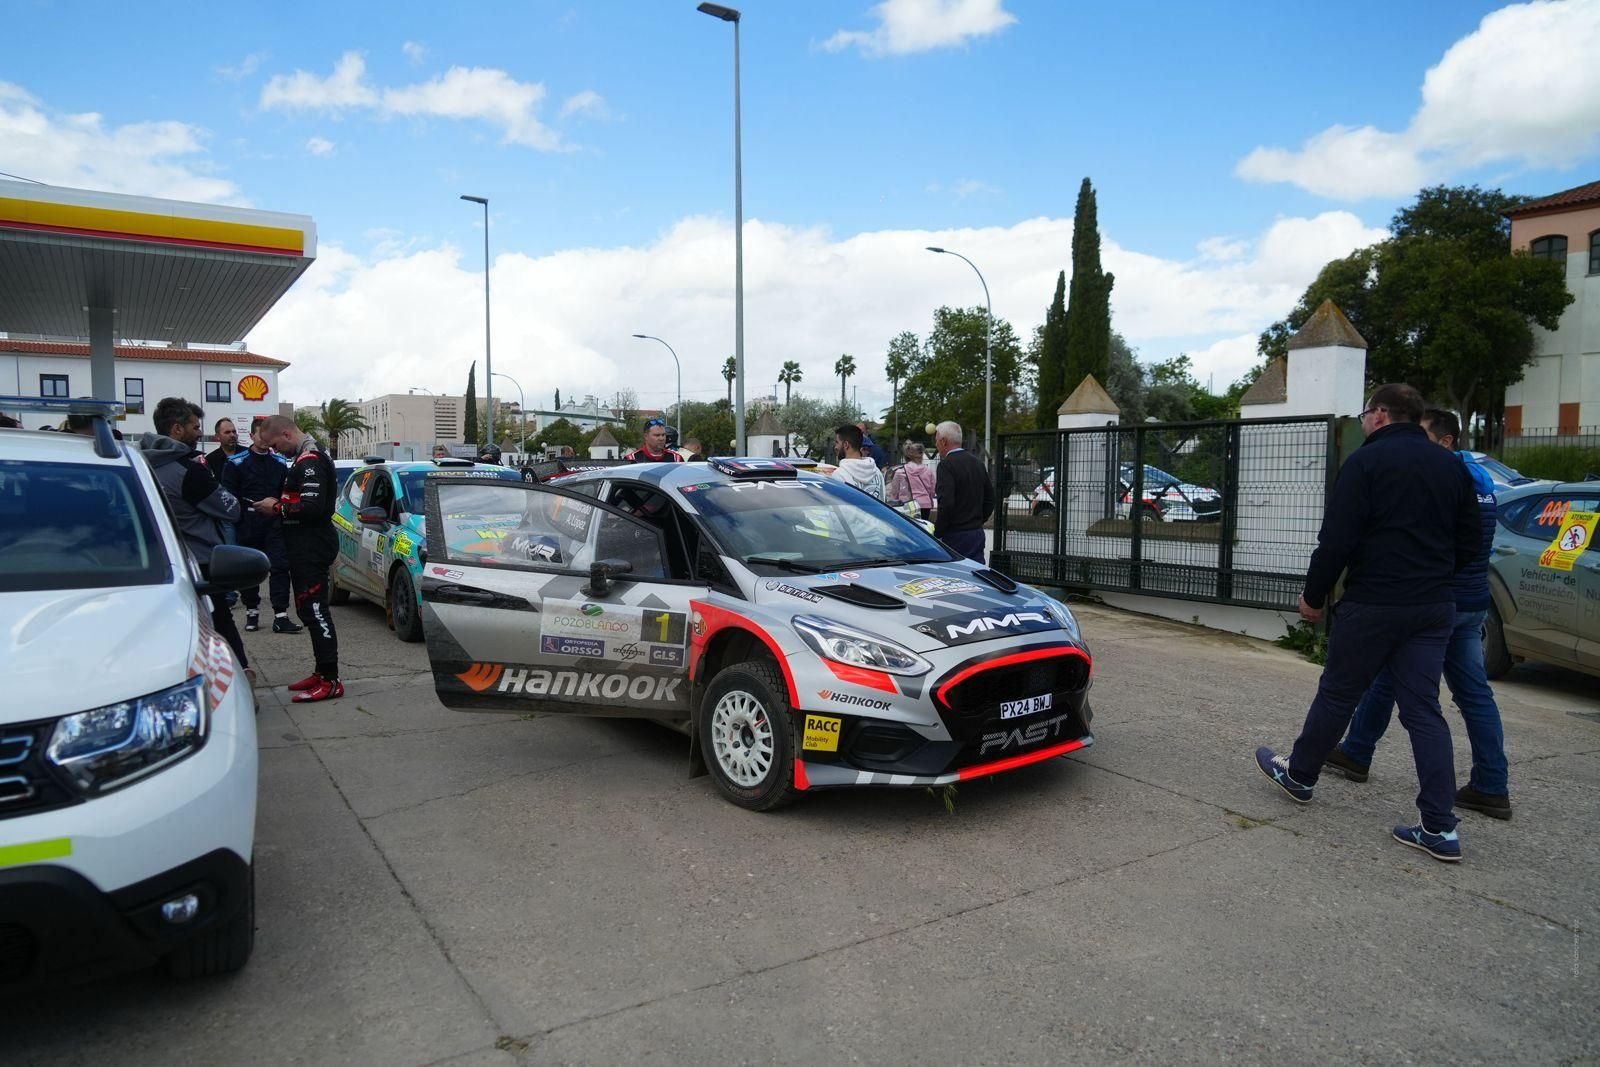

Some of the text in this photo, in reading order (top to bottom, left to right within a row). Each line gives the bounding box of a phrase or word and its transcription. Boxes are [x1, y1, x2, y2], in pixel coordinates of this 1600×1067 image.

[1563, 575, 1576, 586] de
[553, 616, 629, 632] POZOBLANCO
[655, 613, 671, 642] 1
[946, 612, 1051, 640] MMR
[561, 645, 602, 656] ORSSO
[1001, 699, 1030, 718] PX24
[807, 718, 839, 733] RACC
[805, 735, 829, 744] Mobility
